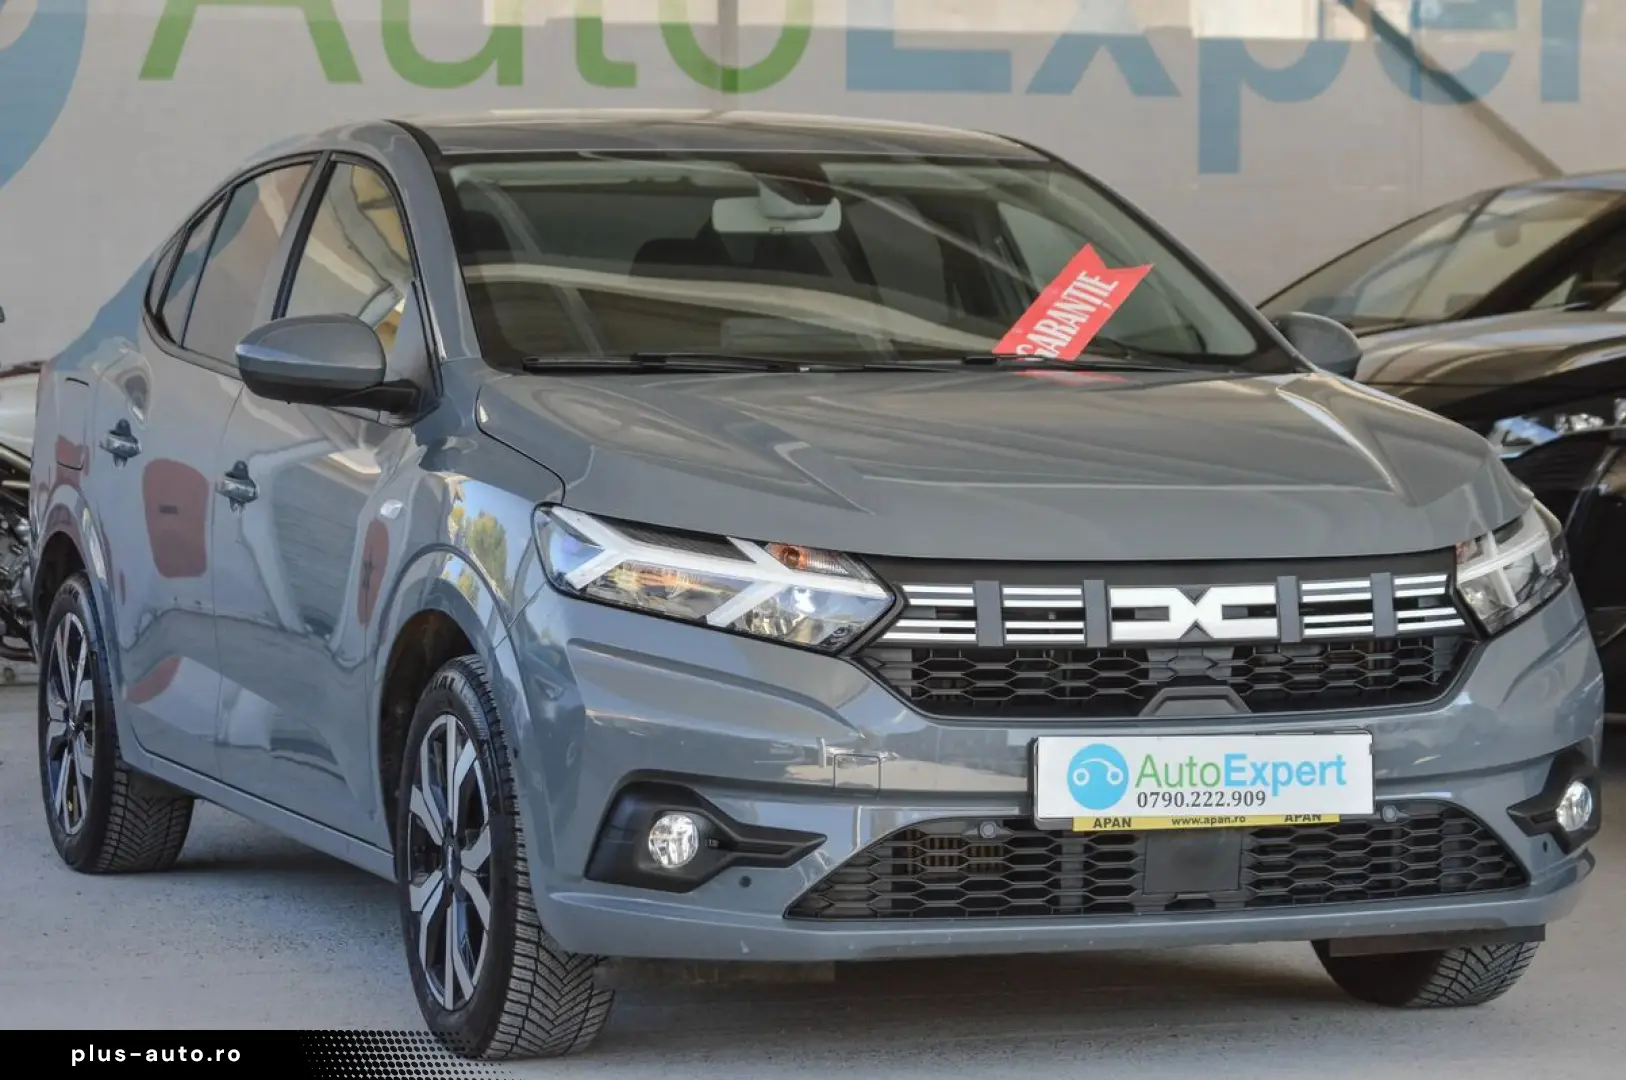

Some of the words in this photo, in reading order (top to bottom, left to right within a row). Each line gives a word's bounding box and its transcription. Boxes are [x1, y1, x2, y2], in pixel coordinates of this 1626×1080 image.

[1134, 753, 1347, 796] AutoExpert
[1136, 790, 1267, 809] 0790.222.909
[1092, 817, 1132, 829] APAN
[1171, 814, 1247, 826] www.apan.ro
